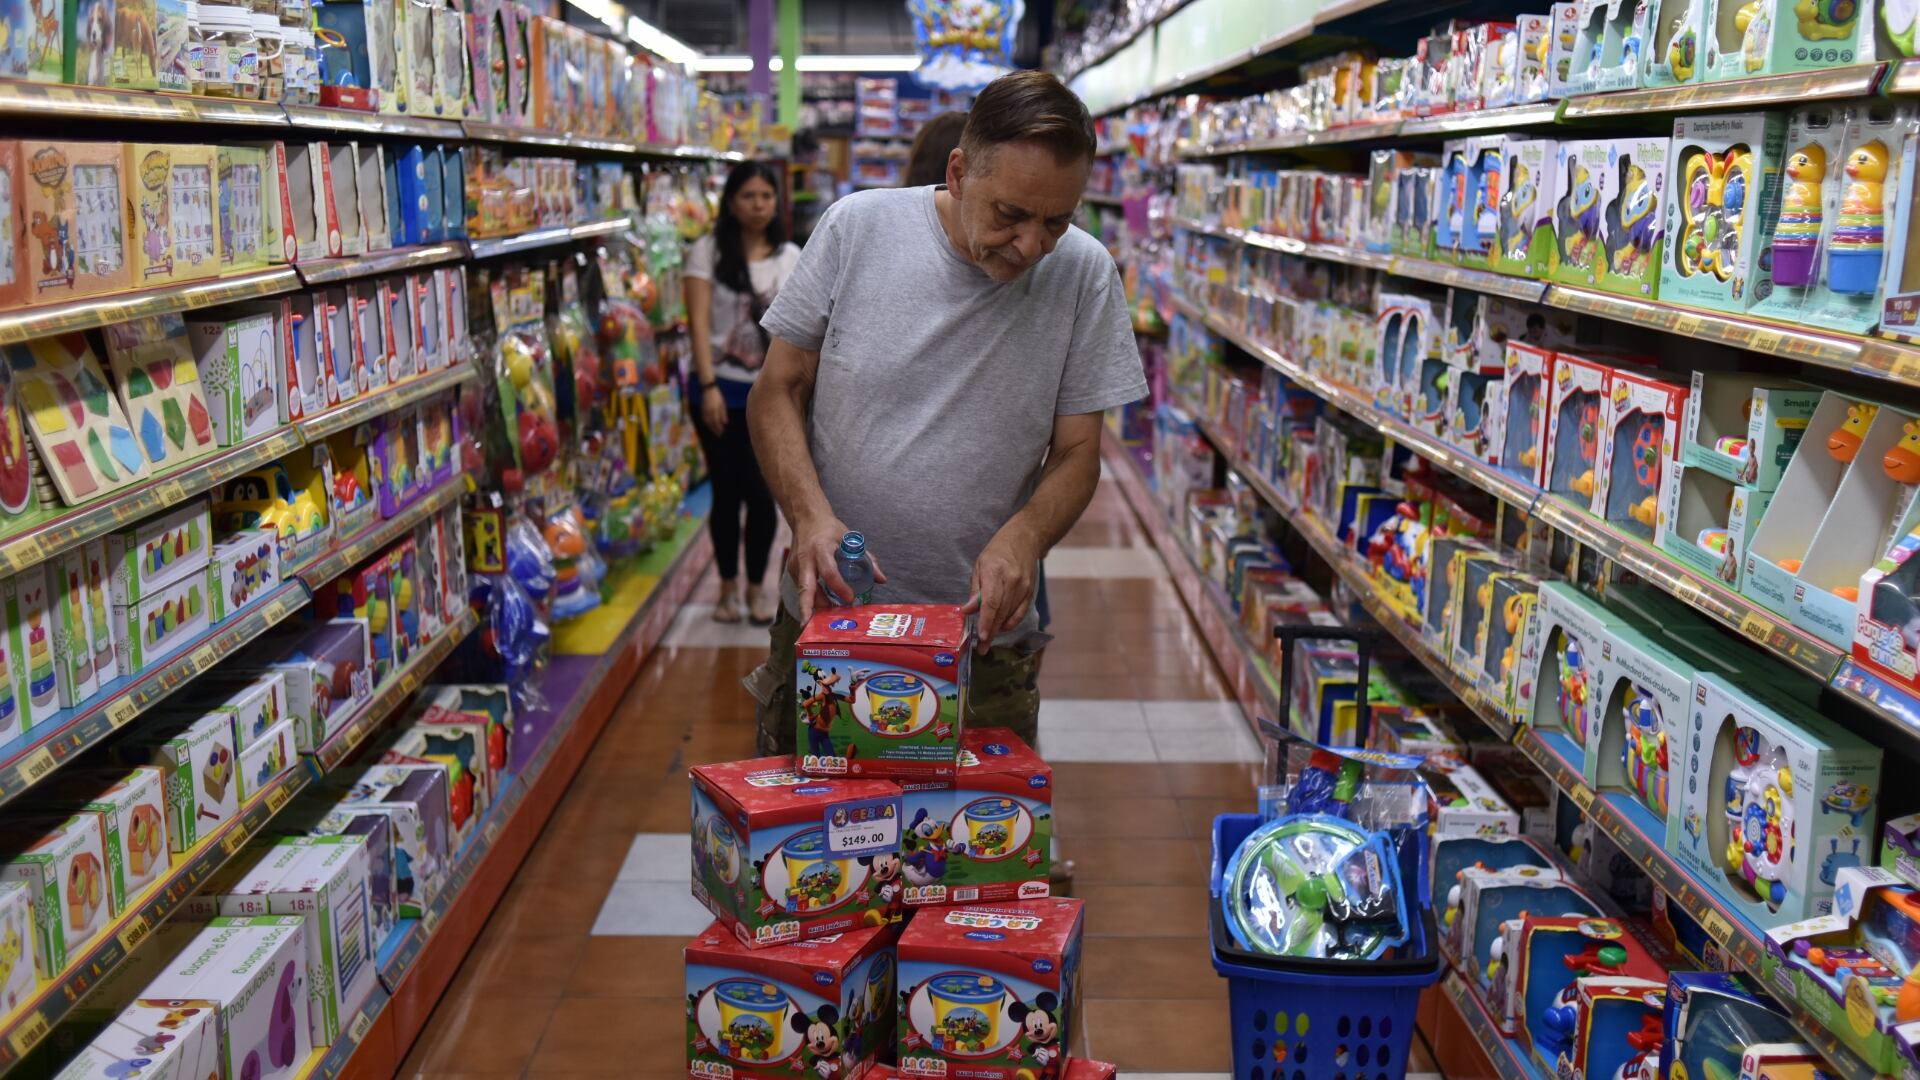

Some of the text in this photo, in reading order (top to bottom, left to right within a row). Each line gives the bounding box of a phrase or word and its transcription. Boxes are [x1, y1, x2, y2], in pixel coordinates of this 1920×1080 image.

[1784, 399, 1810, 408] Small
[934, 655, 953, 664] Disney
[805, 755, 847, 768] LA CASA
[1030, 777, 1047, 785] Disney
[850, 804, 895, 823] CEBRA
[842, 833, 884, 847] $149.00
[905, 886, 945, 898] LA CASA
[758, 922, 799, 938] LA CASA
[1033, 962, 1052, 971] Disney
[815, 975, 833, 984] Disney
[230, 1002, 245, 1020] Dog
[693, 1060, 733, 1076] LA CASA
[904, 1059, 945, 1071] LA CASA
